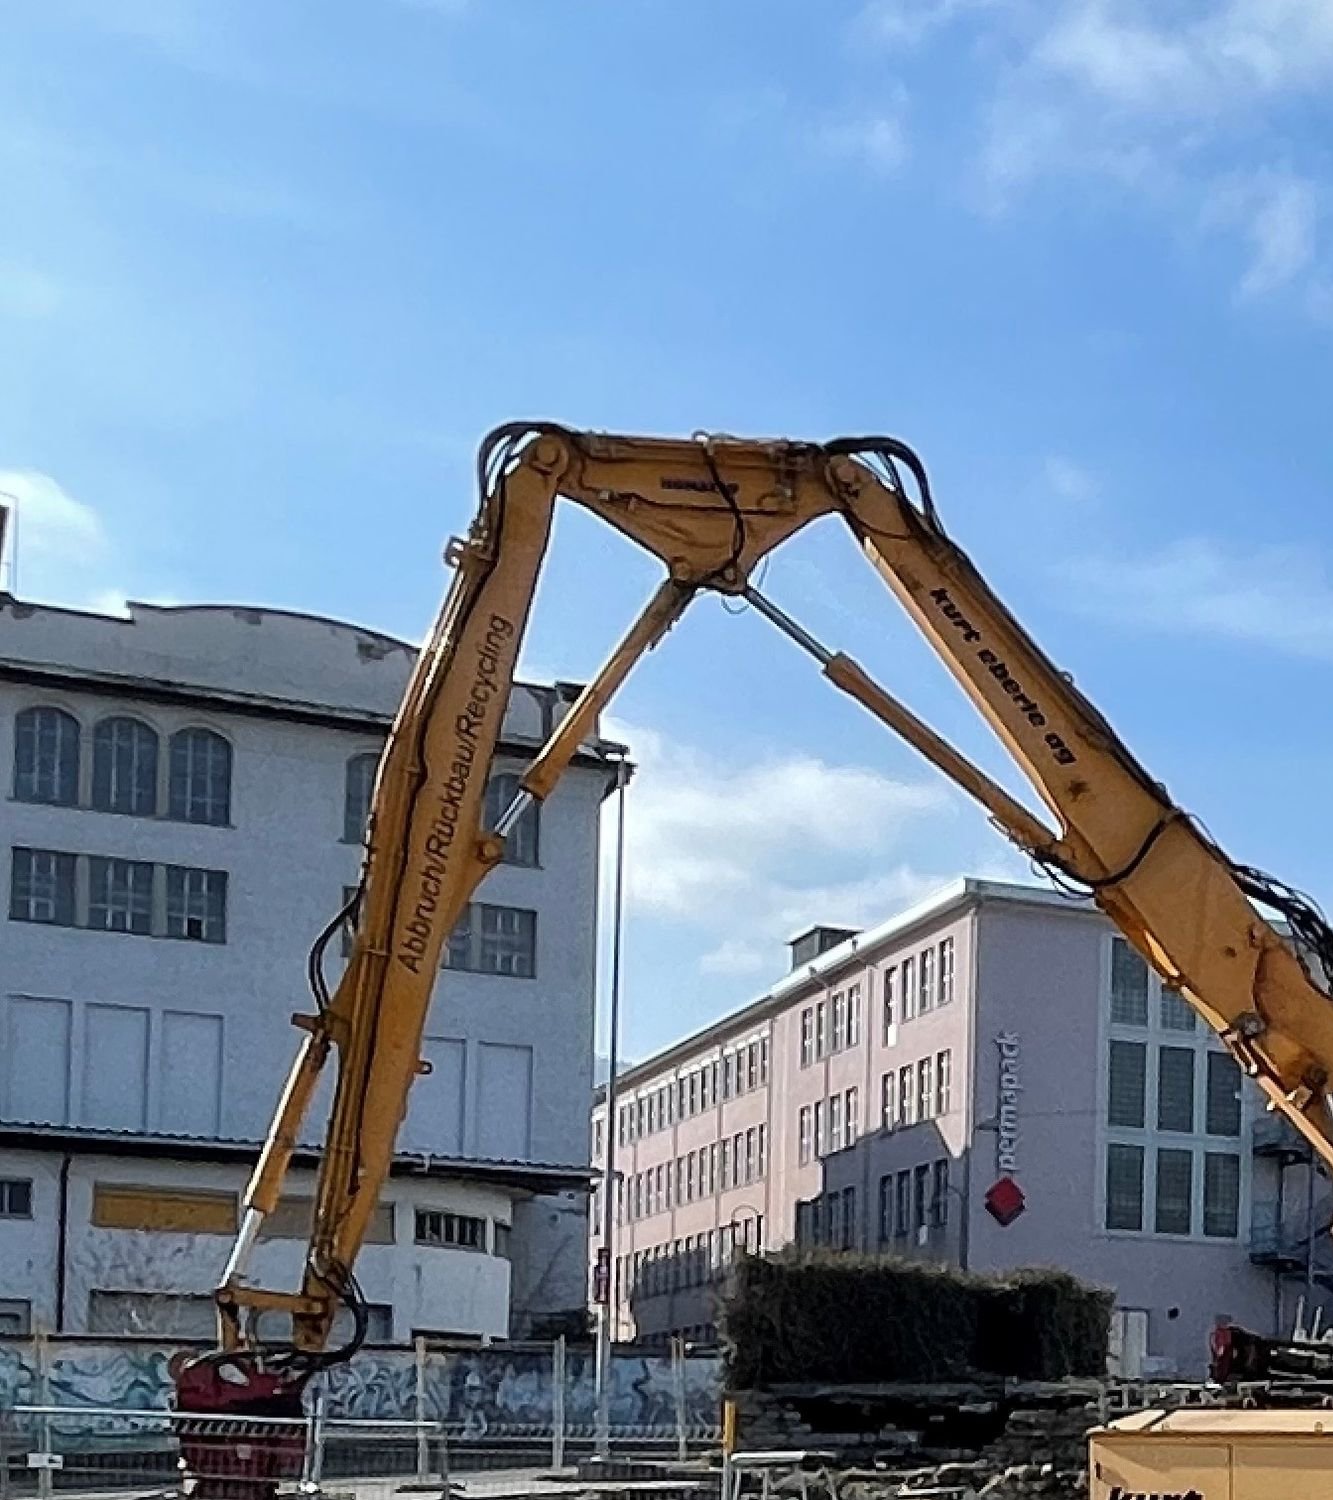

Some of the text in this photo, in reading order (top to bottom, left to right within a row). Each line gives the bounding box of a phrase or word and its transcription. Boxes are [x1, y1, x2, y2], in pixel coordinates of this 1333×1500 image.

[929, 587, 1077, 766] kurt eberle ag
[397, 614, 515, 975] Abbruch/Rückbau/Recycling
[996, 1031, 1024, 1172] permapack
